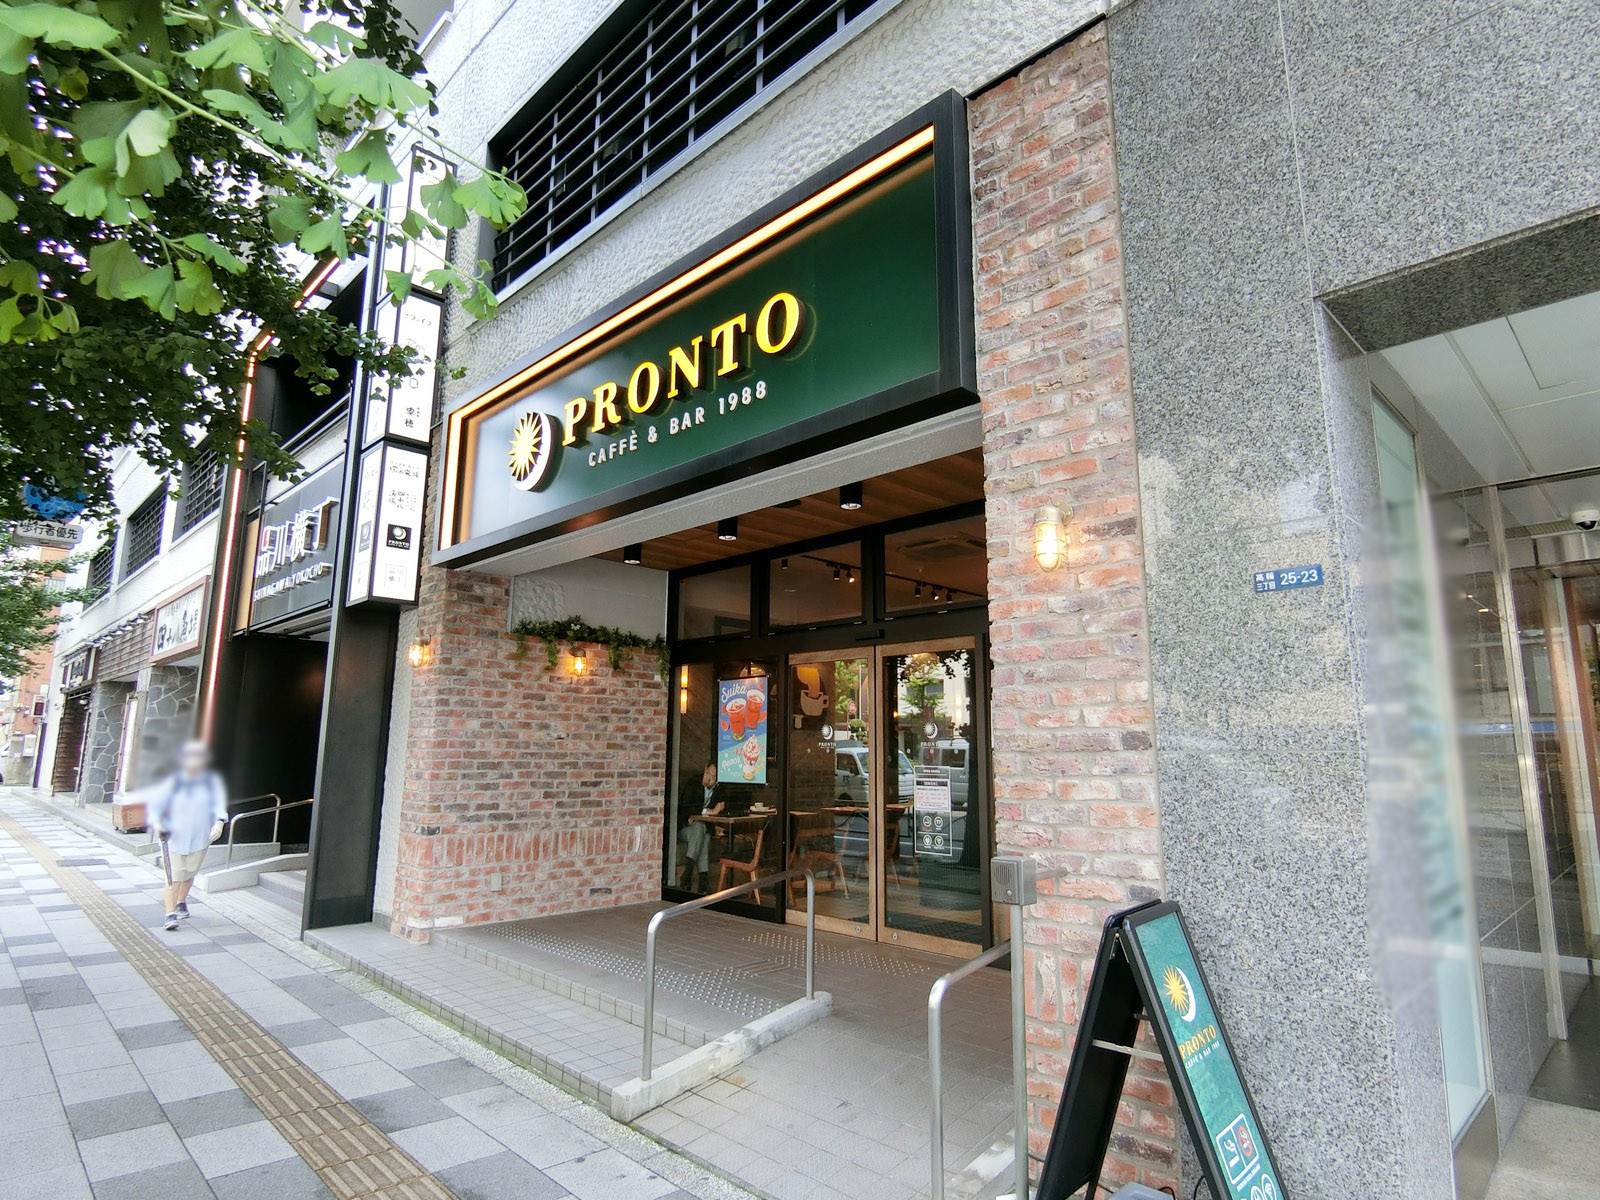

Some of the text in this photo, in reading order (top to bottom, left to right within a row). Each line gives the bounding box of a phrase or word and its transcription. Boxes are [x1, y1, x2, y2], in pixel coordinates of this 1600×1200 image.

[562, 292, 800, 446] PRONTO
[588, 381, 768, 467] CAFFÈ & BAR 1988
[22, 519, 78, 540] 歩行者優先
[292, 562, 324, 584] YOKOCHO
[1279, 569, 1319, 586] 25-23
[1256, 581, 1276, 591] 三丁目
[721, 682, 747, 703] Suika
[1178, 1024, 1217, 1060] PRONTO
